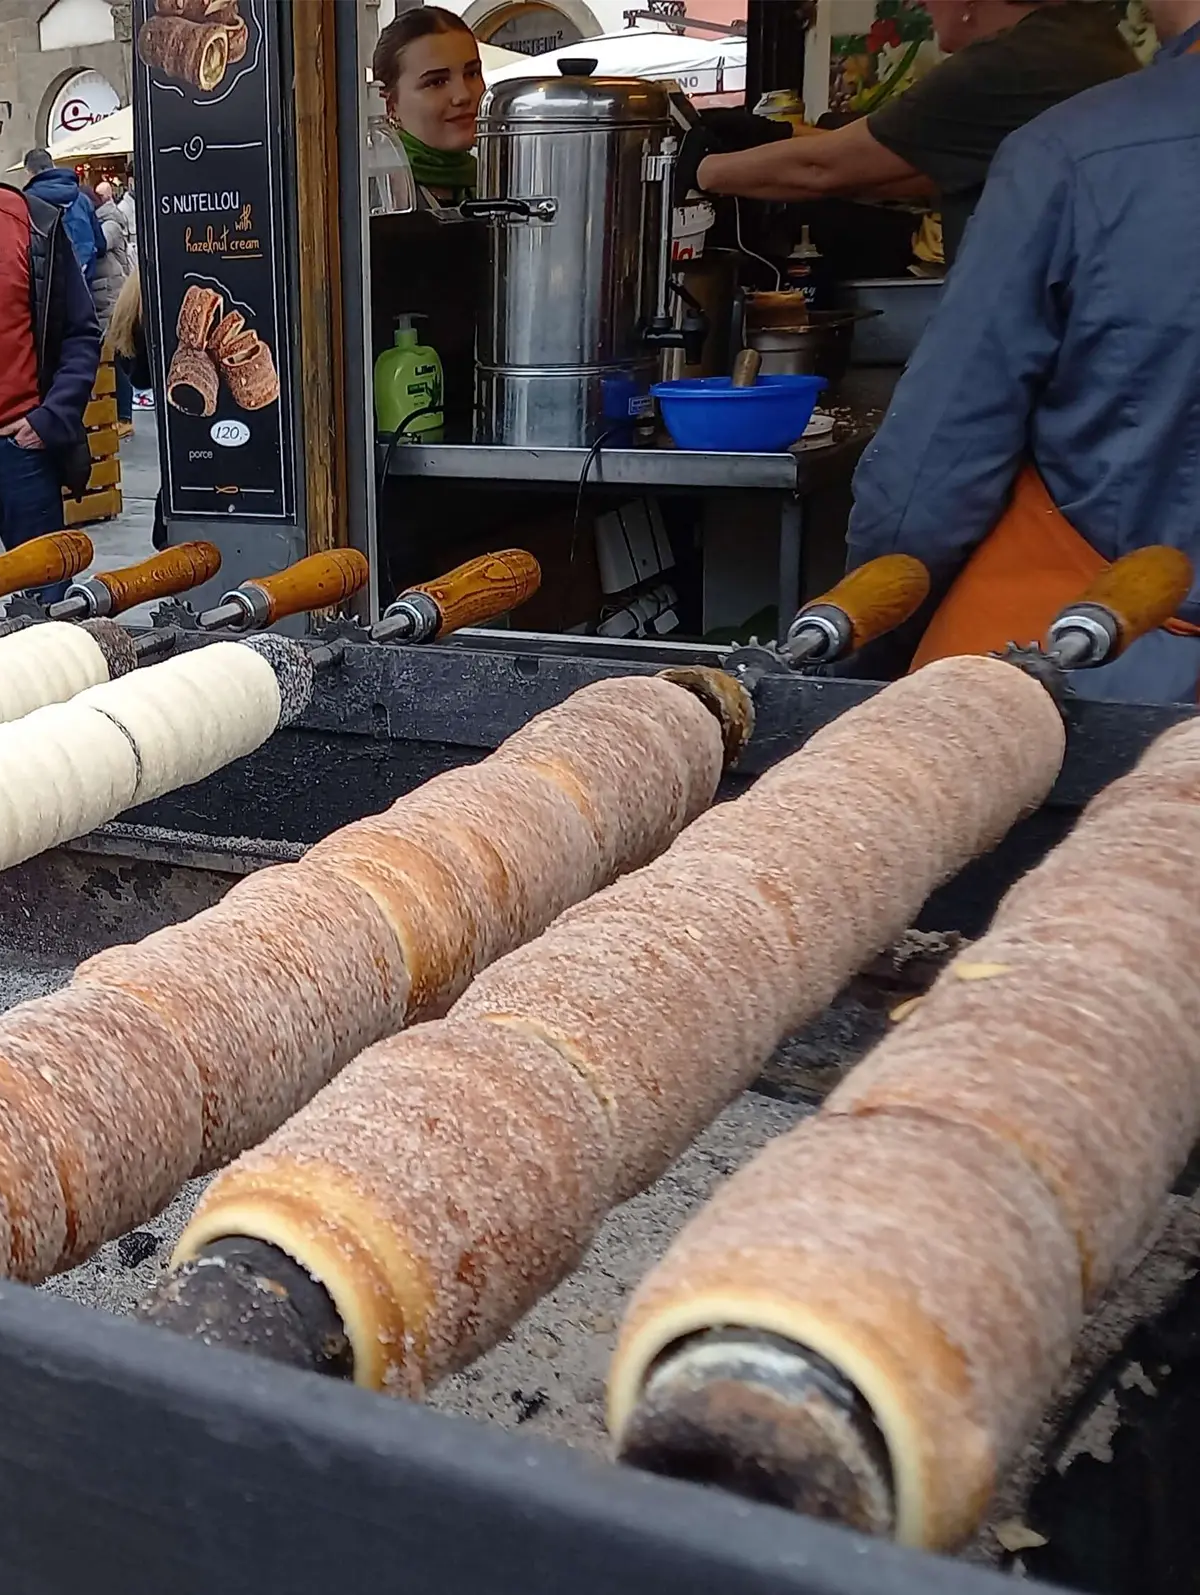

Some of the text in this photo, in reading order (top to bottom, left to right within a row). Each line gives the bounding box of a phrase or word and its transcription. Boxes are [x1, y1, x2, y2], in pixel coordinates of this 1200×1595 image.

[161, 191, 239, 214] S NUTELLOU
[234, 204, 252, 231] with
[185, 225, 260, 254] hazelnut cream
[215, 426, 249, 441] 120,-
[189, 450, 213, 462] porce
